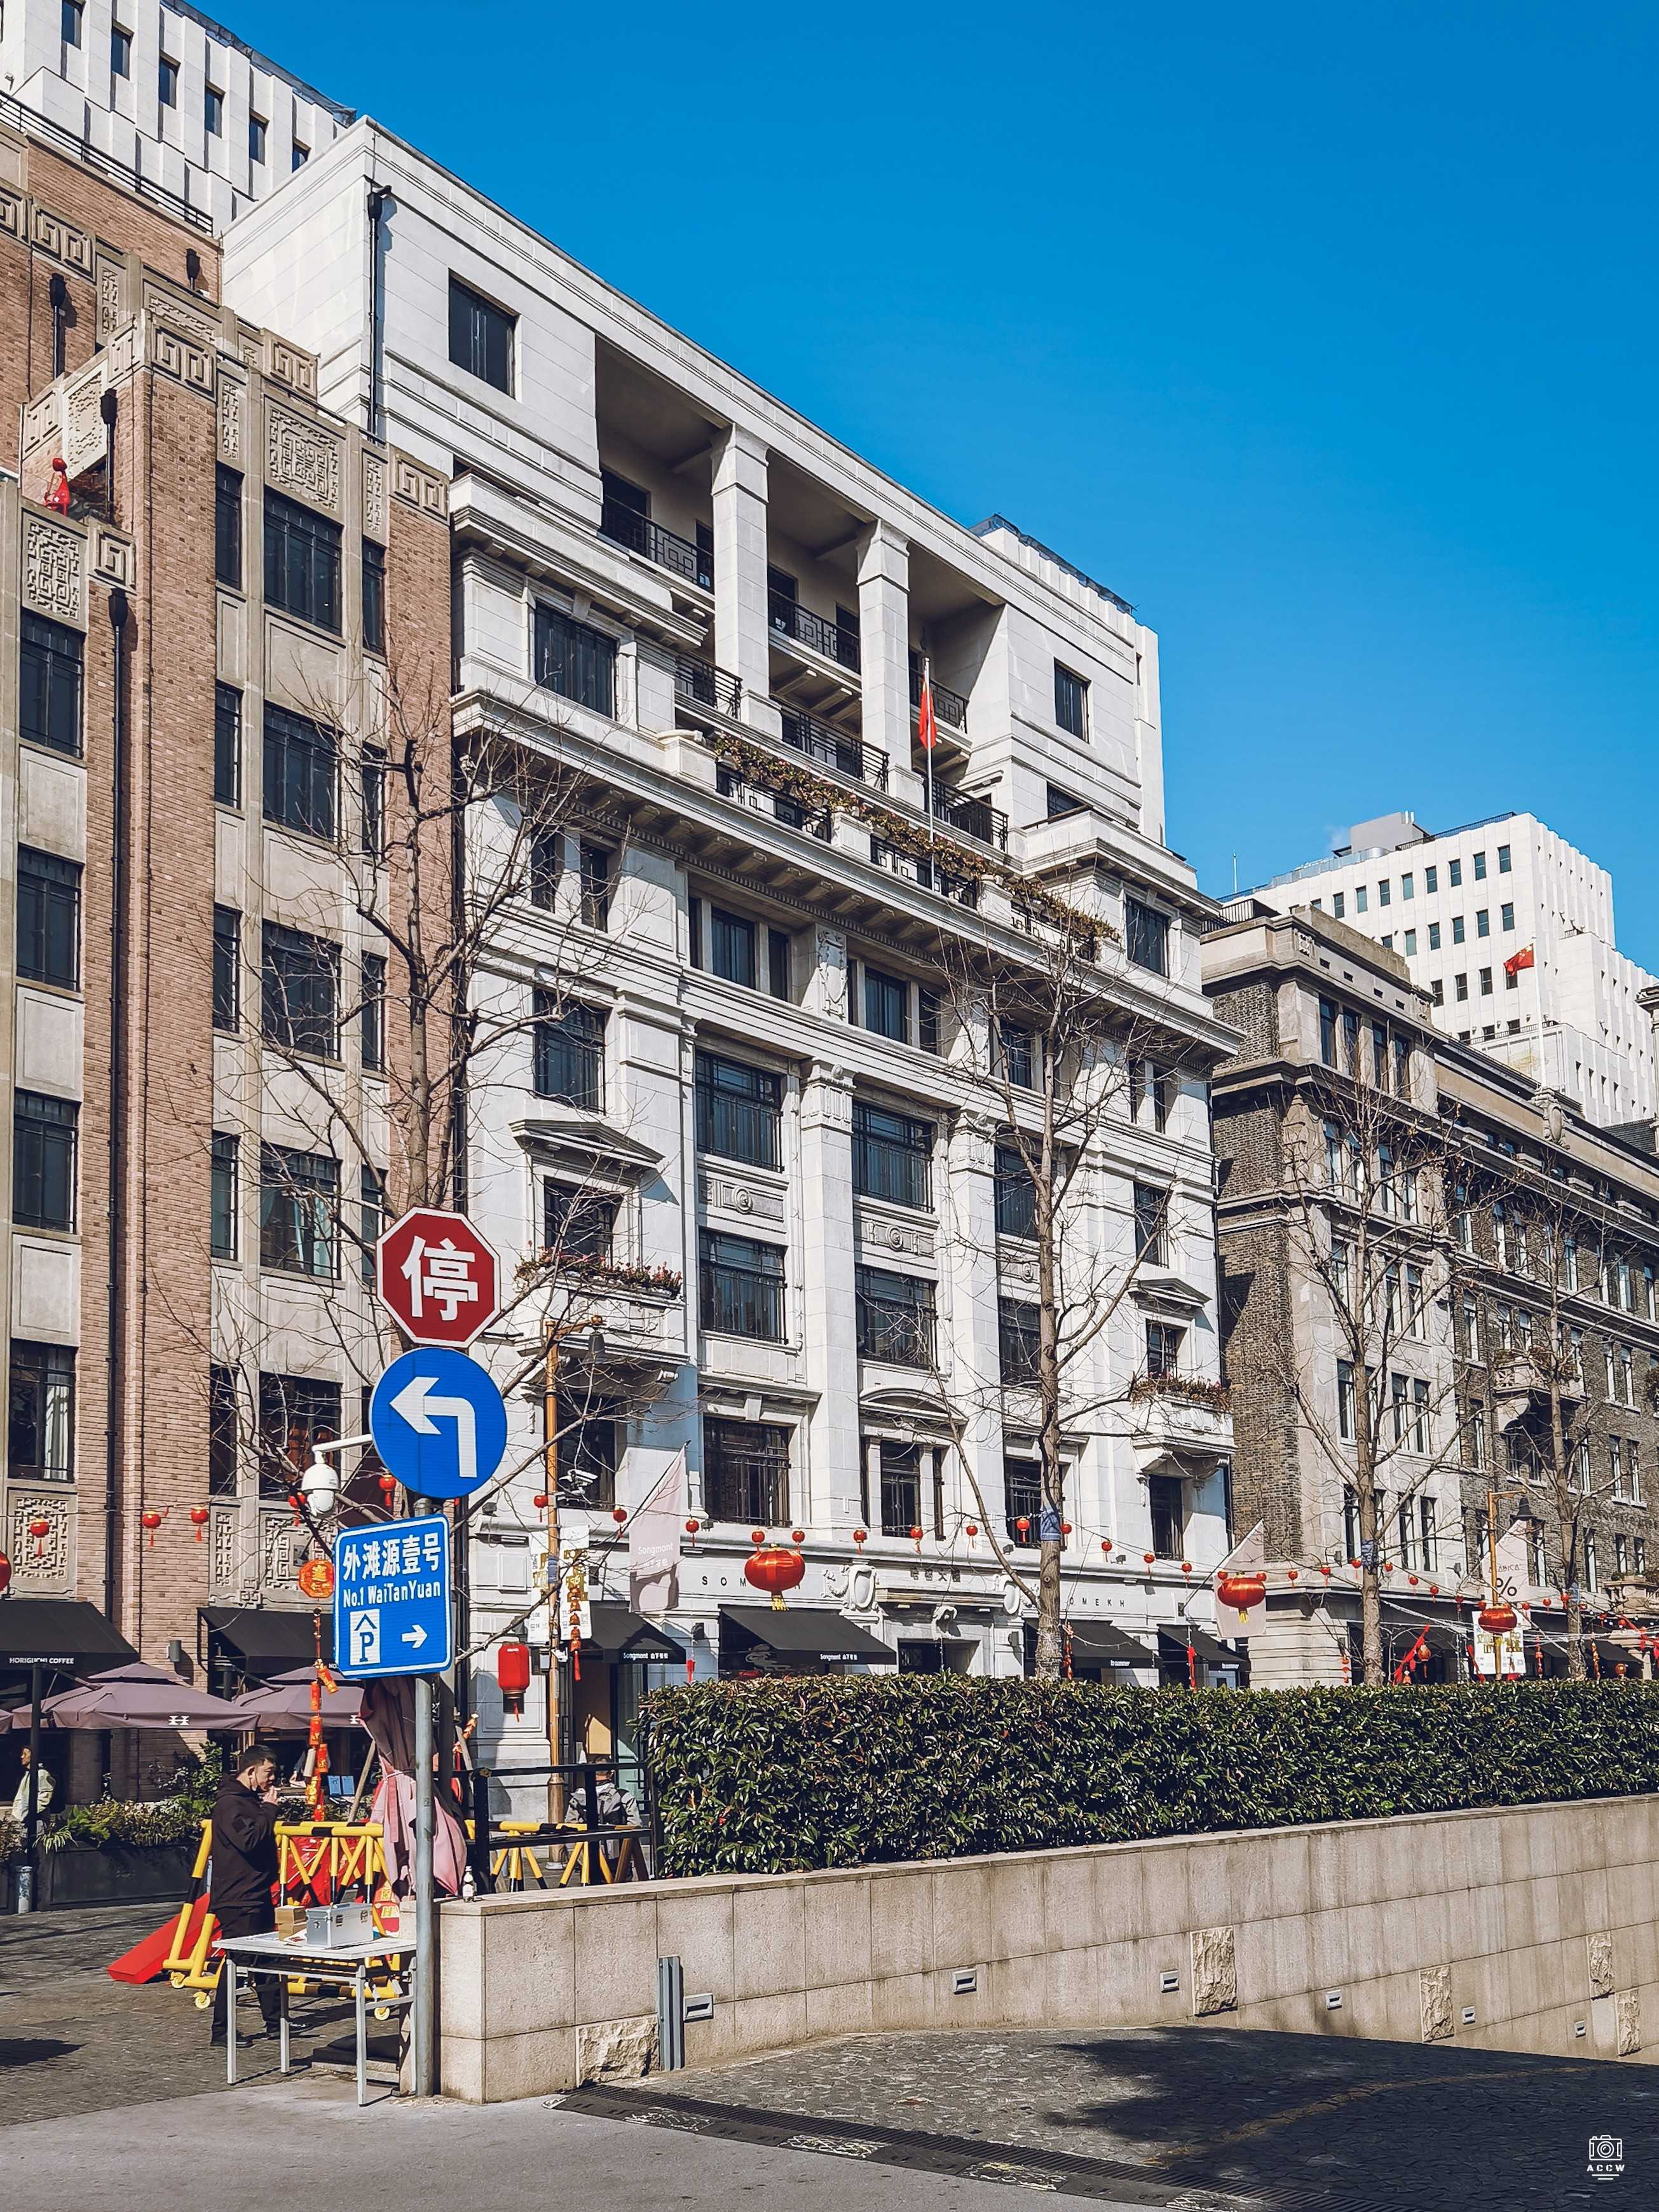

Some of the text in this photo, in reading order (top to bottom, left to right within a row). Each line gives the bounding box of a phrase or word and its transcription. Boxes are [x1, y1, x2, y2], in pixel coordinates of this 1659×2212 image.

[400, 1235, 479, 1321] 停
[343, 1532, 441, 1581] 外滩源壹号
[637, 1543, 674, 1556] Songmont
[1488, 1564, 1520, 1573] AABICA
[343, 1580, 440, 1608] No.1 WaiTanYuan
[1069, 1596, 1124, 1608] OMEKH
[359, 1631, 374, 1663] P
[623, 1653, 649, 1661] Songmont
